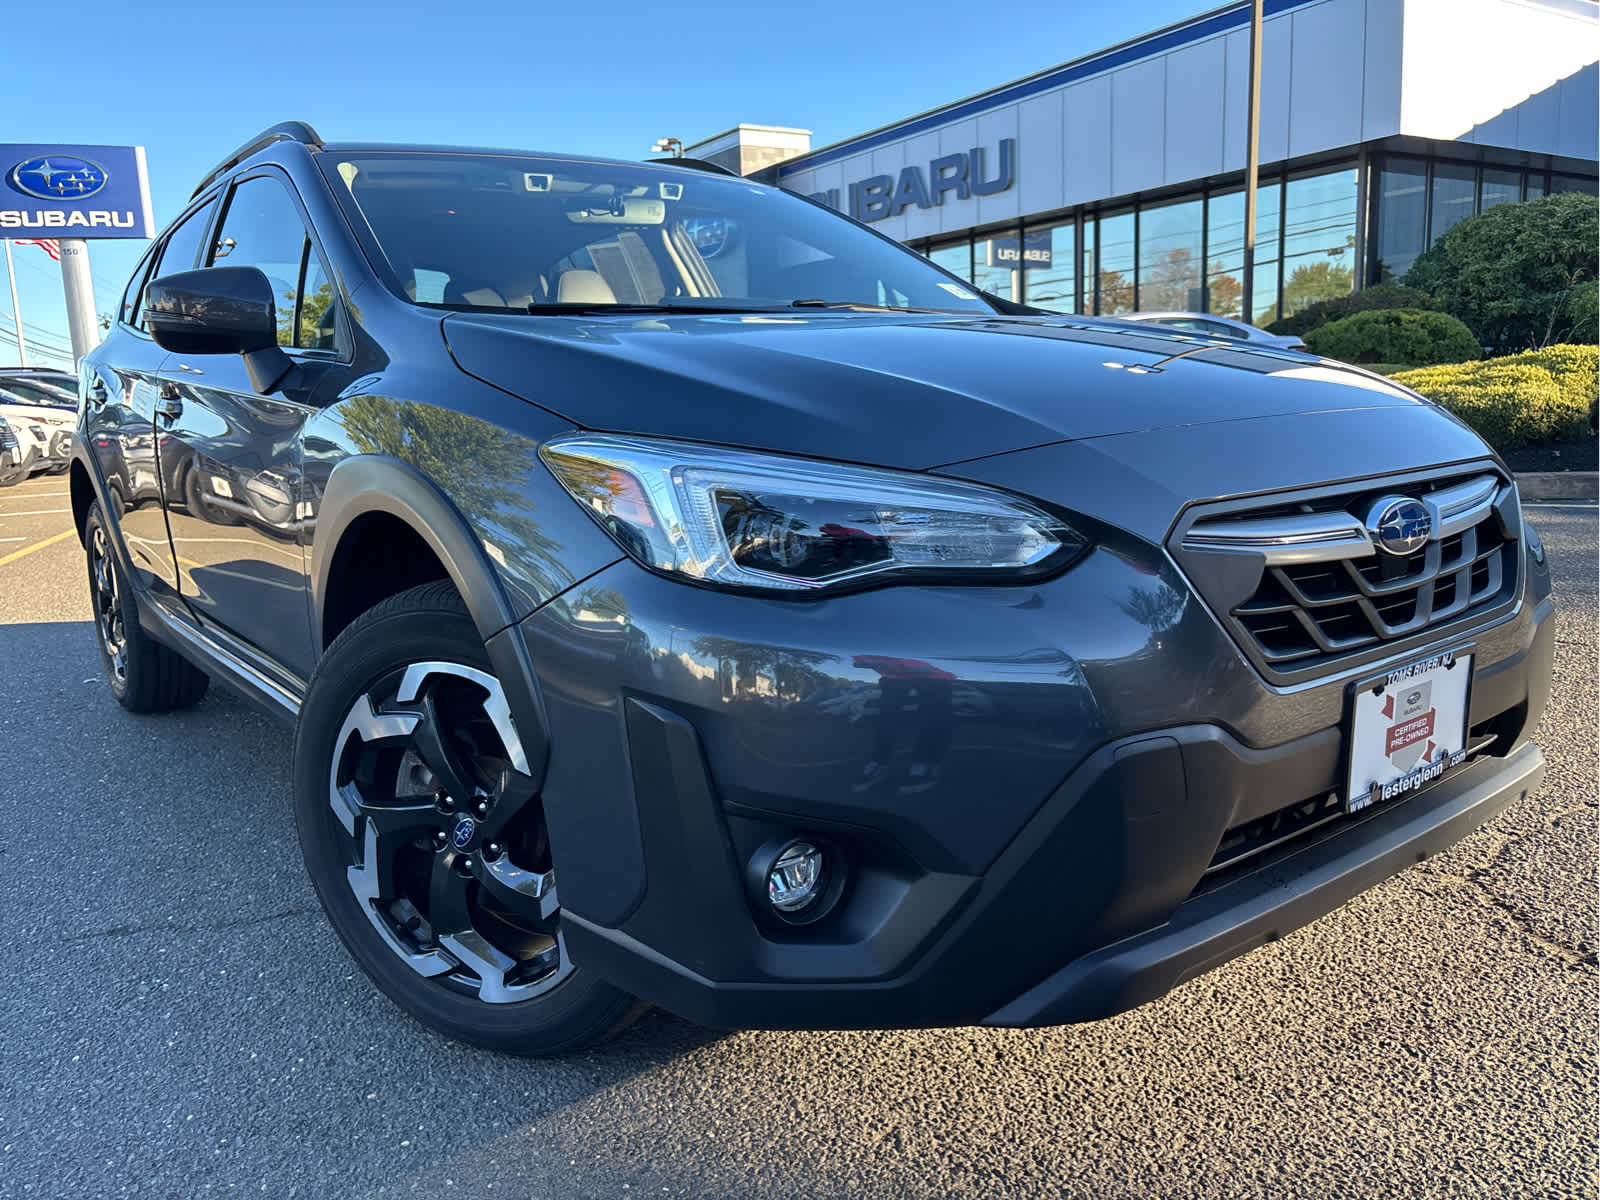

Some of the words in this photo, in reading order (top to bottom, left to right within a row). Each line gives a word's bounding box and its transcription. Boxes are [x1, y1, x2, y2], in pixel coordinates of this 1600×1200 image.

[0, 210, 135, 228] SUBARU
[1388, 667, 1412, 683] TOMS
[1442, 652, 1453, 666] NJ
[1390, 726, 1430, 749] PRE-OWNED
[1395, 717, 1428, 737] CERTIFIED
